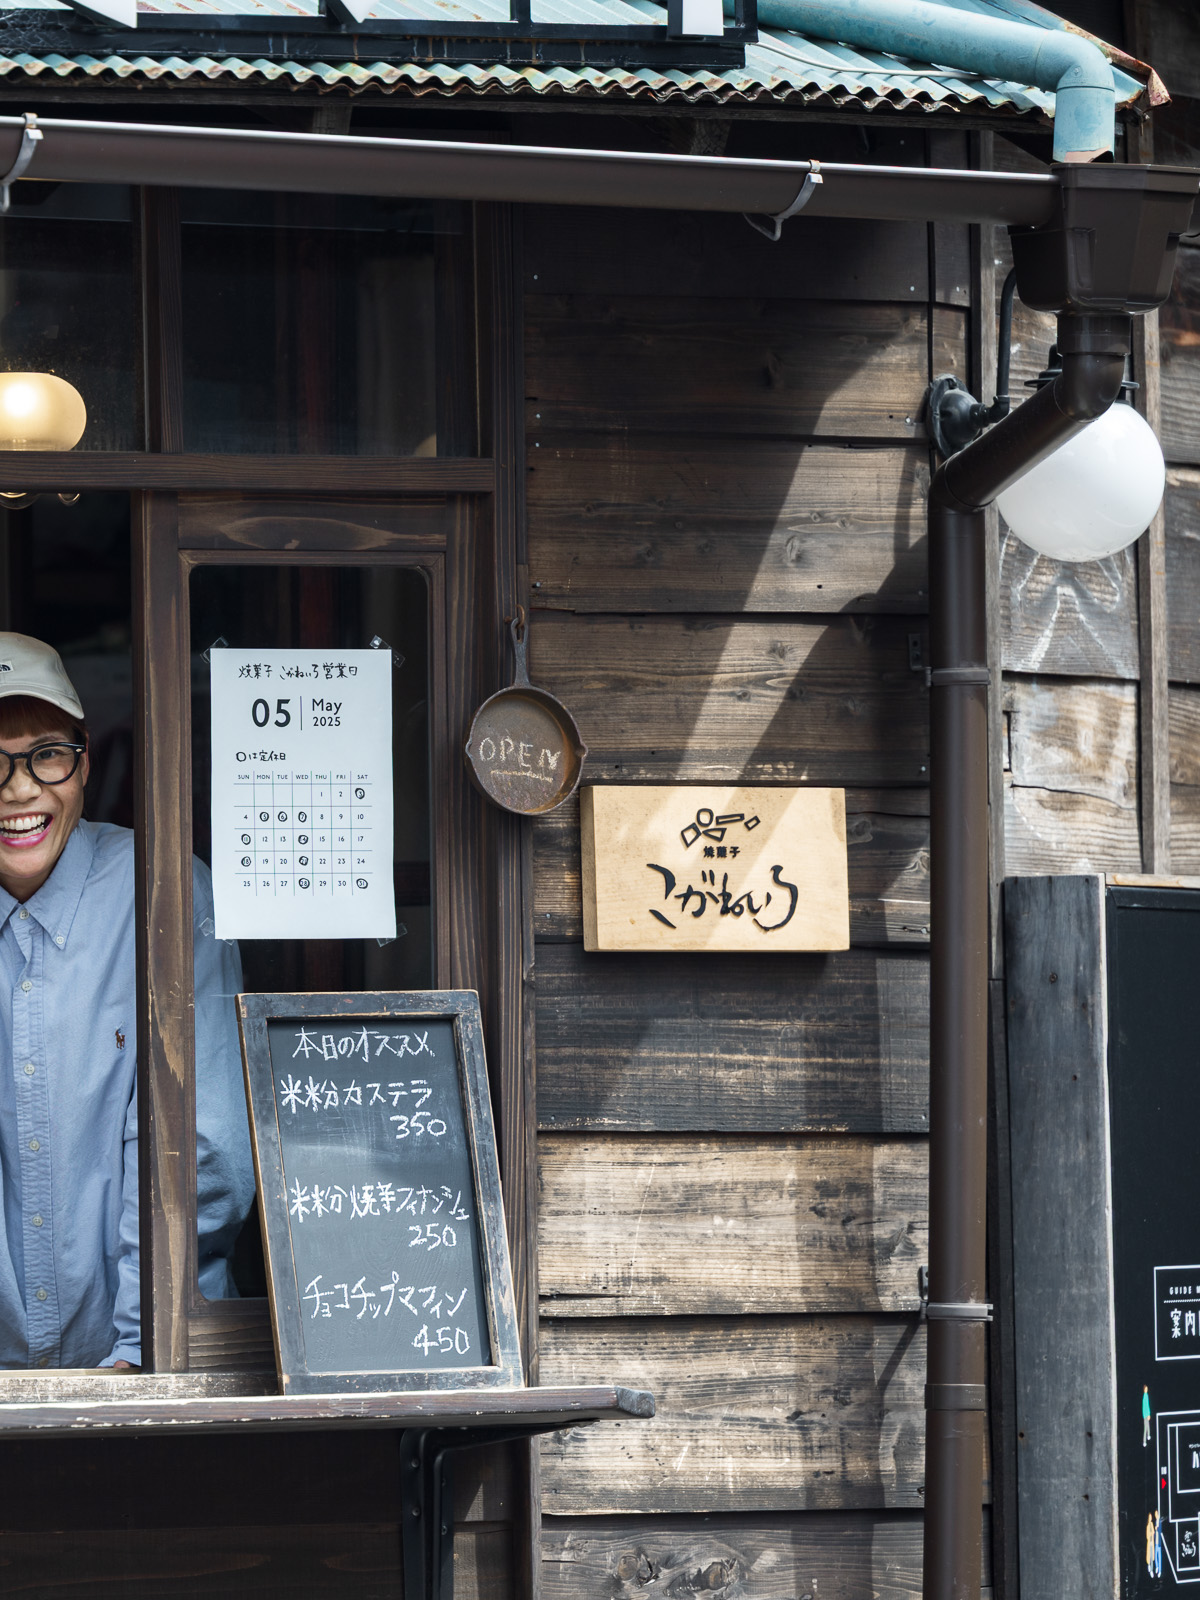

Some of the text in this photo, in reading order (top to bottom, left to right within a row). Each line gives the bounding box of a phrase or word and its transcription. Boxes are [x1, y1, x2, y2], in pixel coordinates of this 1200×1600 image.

[251, 698, 291, 728] 05
[311, 698, 343, 715] May
[312, 716, 341, 727] 2025
[479, 736, 561, 770] OPEN
[280, 1073, 433, 1115] 米粉カステラ
[389, 1111, 448, 1140] 350
[408, 1222, 457, 1252] 250
[302, 1270, 468, 1321] チョコチップマフィン
[1169, 1285, 1192, 1295] GUIDE
[1170, 1308, 1200, 1339] 案内
[411, 1323, 471, 1357] 450
